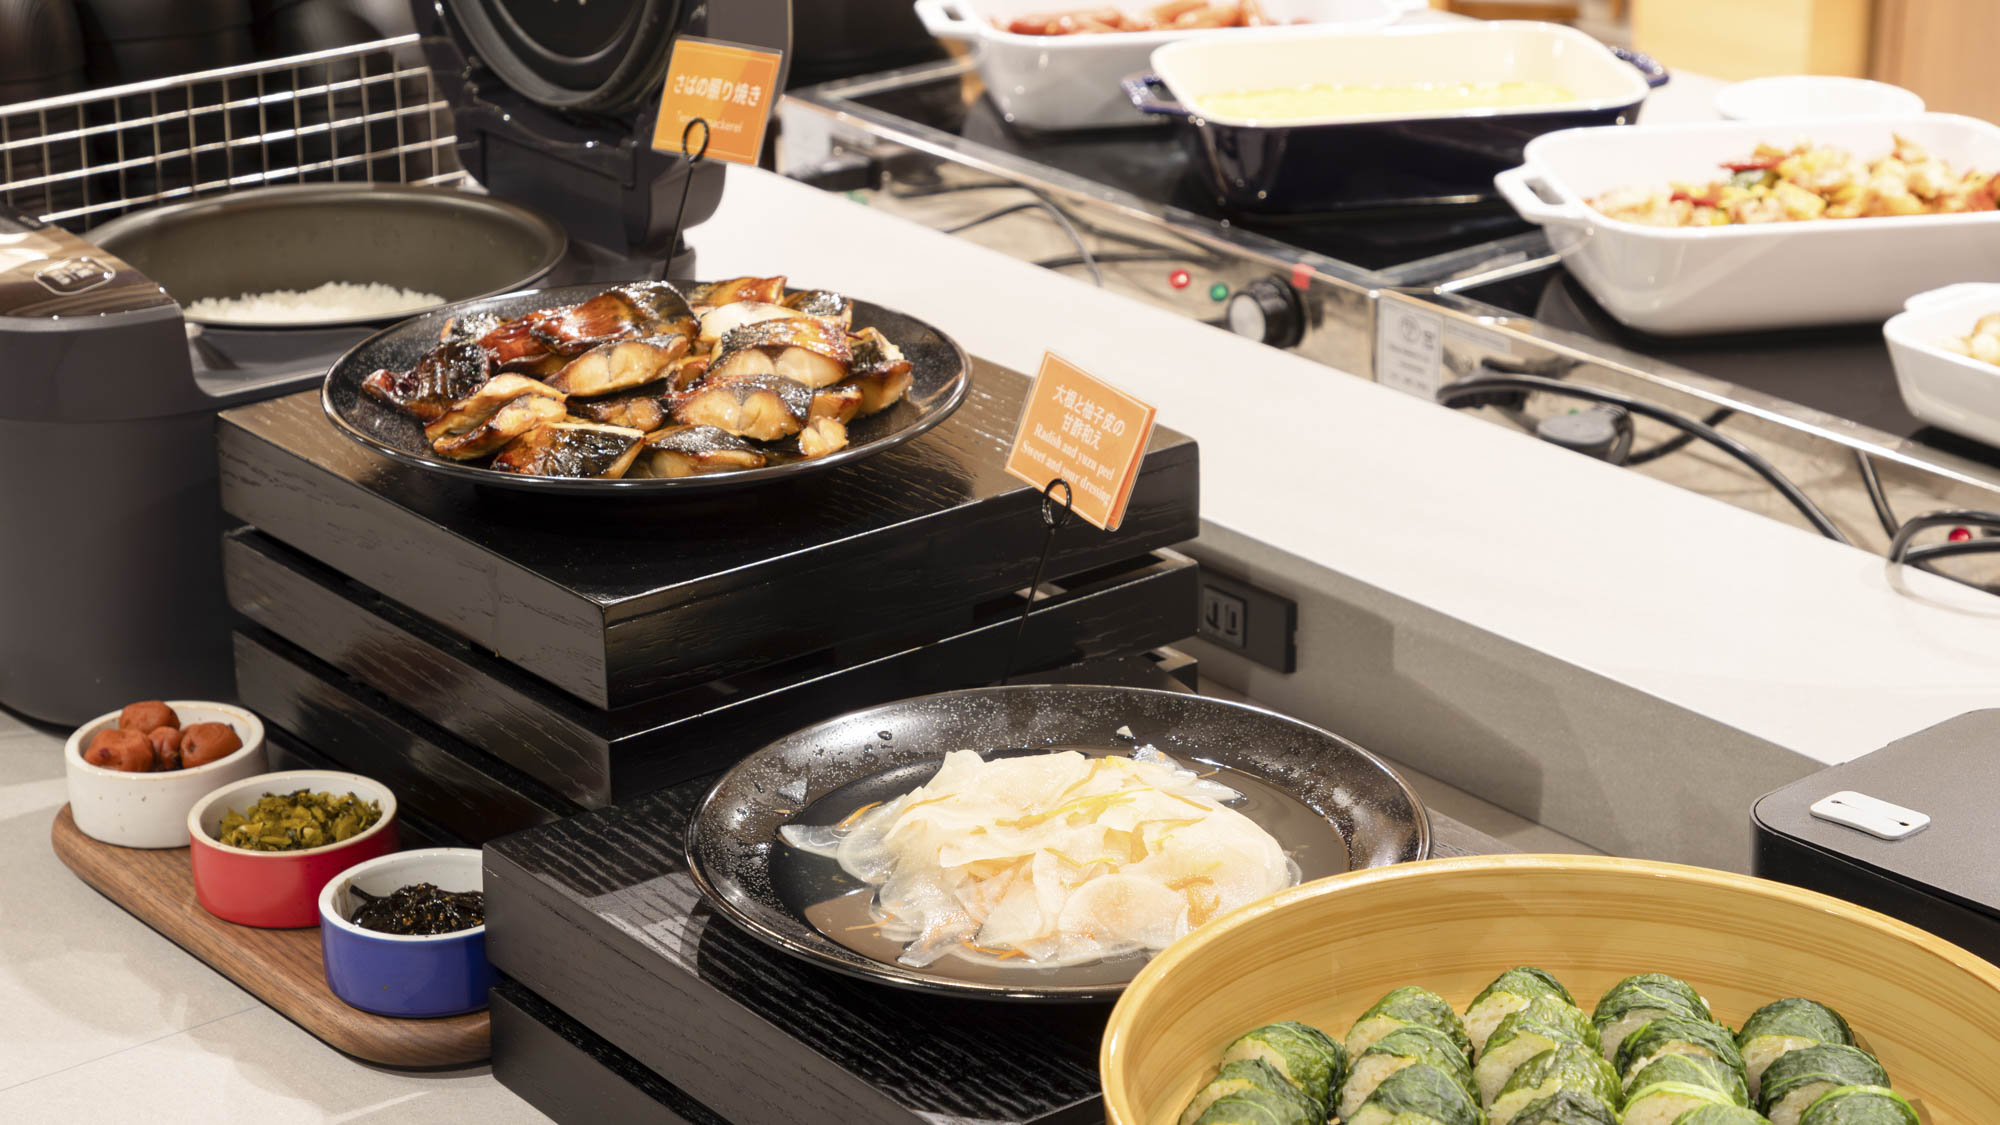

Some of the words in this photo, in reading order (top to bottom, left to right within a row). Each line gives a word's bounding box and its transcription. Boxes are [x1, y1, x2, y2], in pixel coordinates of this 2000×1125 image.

[673, 73, 762, 107] さばの照り焼き
[1052, 384, 1126, 437] 大根と柚子皮の
[1061, 413, 1103, 450] 甘酢和え
[1020, 439, 1046, 463] Sweet
[1045, 457, 1062, 473] and
[1060, 469, 1081, 484] sour
[1079, 475, 1112, 506] dressing
[1034, 423, 1062, 449] Radish
[1060, 442, 1079, 458] and
[1076, 453, 1097, 470] yuzu
[1096, 464, 1116, 481] peel
